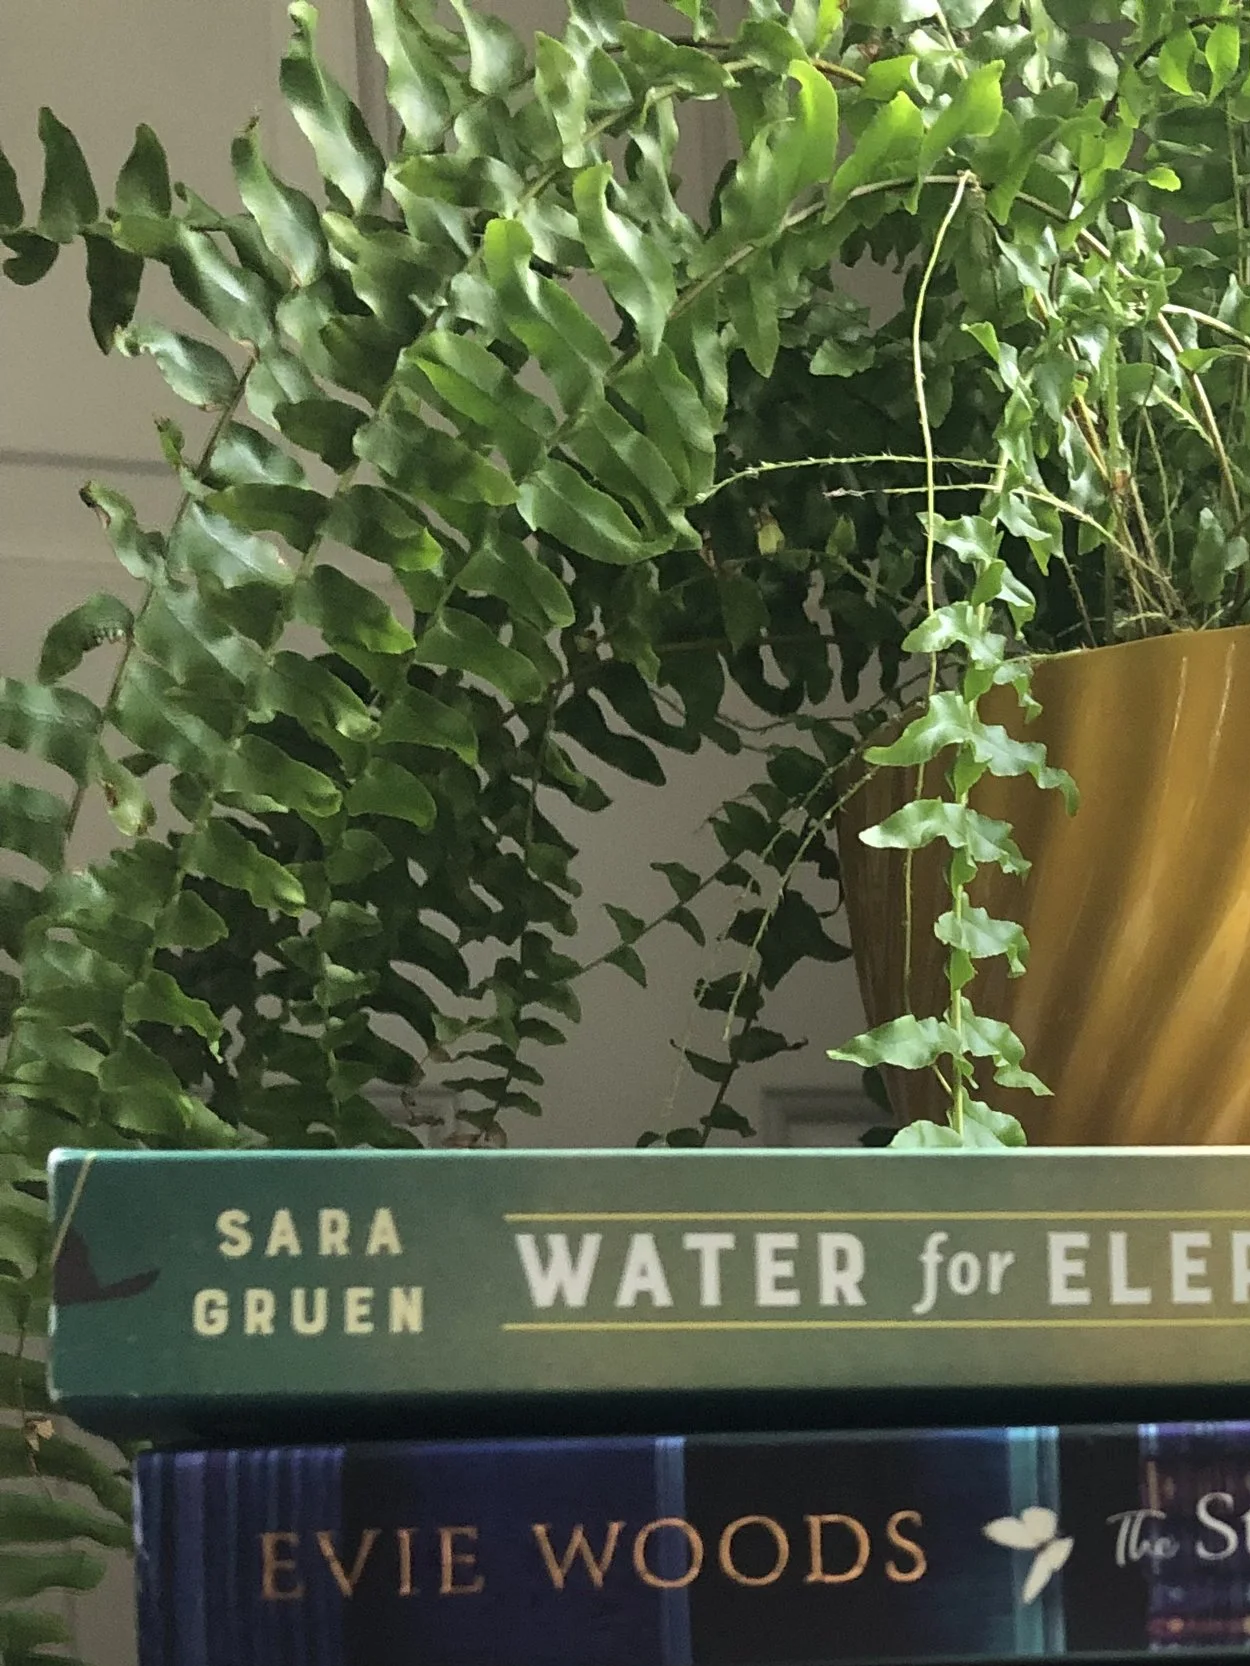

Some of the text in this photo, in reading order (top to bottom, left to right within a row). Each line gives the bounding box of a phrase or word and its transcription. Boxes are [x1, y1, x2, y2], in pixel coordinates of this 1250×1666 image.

[216, 1207, 403, 1258] SARA
[515, 1232, 868, 1308] WATER
[913, 1232, 1016, 1315] for
[193, 1286, 425, 1336] GRUEN
[258, 1510, 929, 1600] EVIE WOODS
[1106, 1508, 1179, 1569] The
